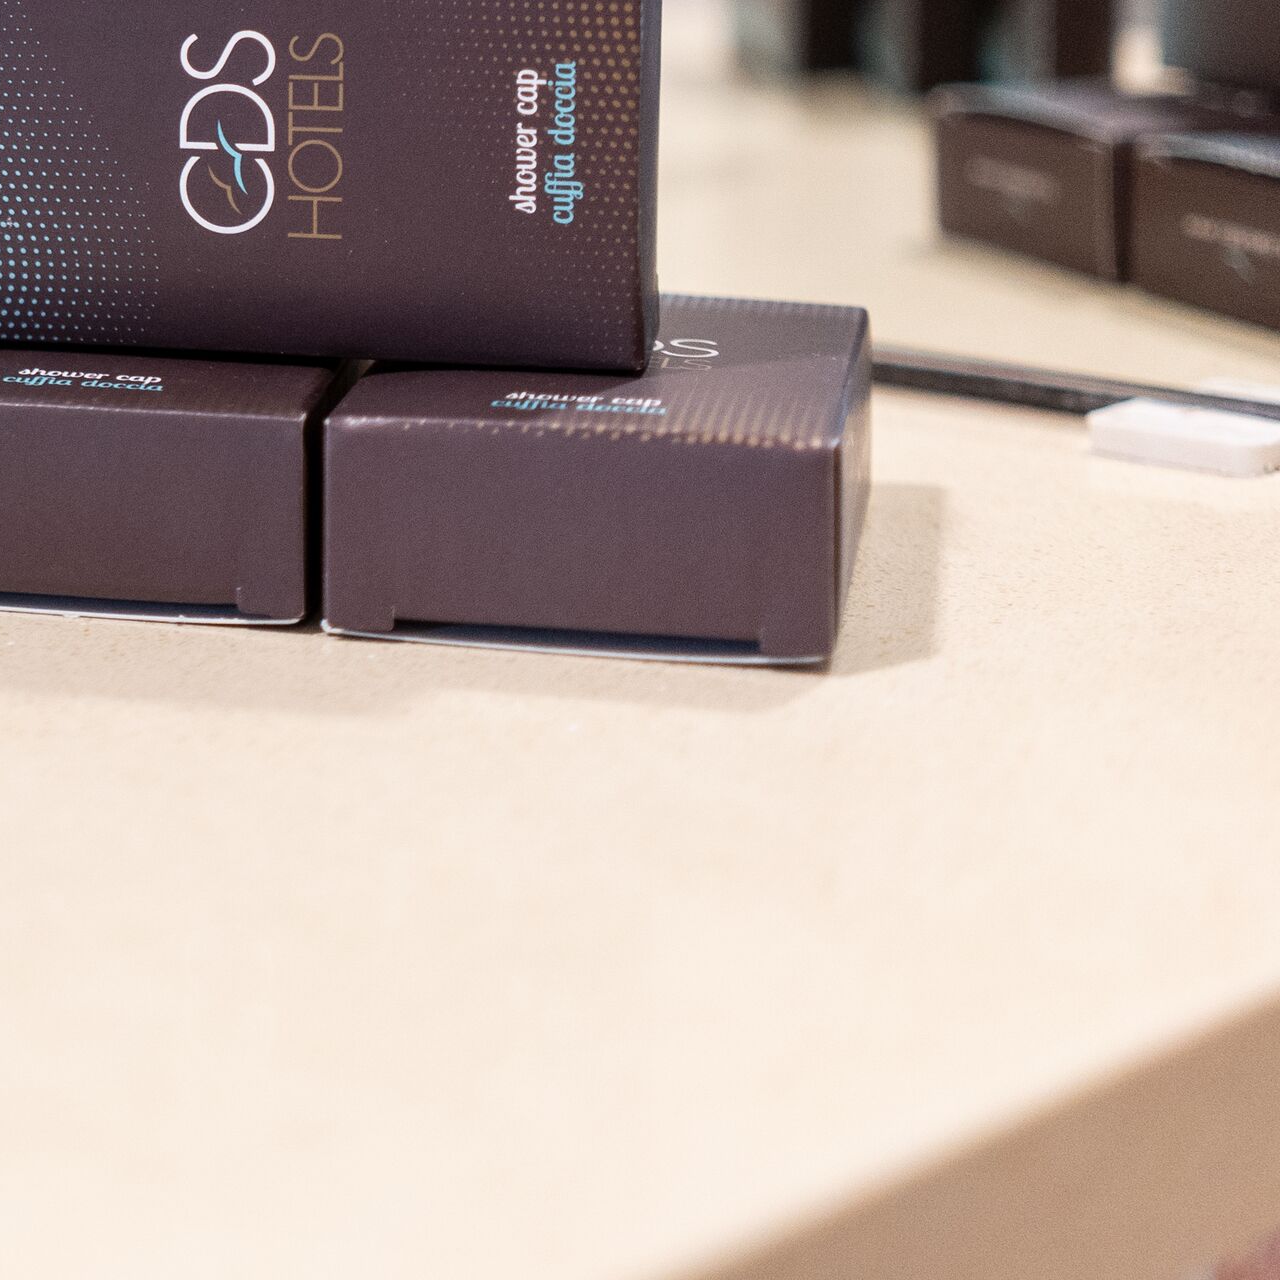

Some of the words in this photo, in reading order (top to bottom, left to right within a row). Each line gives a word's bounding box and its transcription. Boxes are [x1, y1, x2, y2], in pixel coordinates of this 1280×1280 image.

[515, 69, 547, 116] cap
[547, 61, 577, 145] doccia
[179, 30, 276, 235] CDS
[287, 32, 344, 240] HOTELS
[509, 122, 538, 214] shower
[544, 153, 584, 224] cuffia
[2, 375, 72, 386] cuffia
[81, 380, 163, 391] doccia
[18, 368, 110, 380] shower
[115, 374, 162, 385] cap
[505, 391, 604, 403] shower
[611, 396, 662, 407] cap
[491, 399, 567, 410] cuffia
[576, 403, 667, 416] doccia
